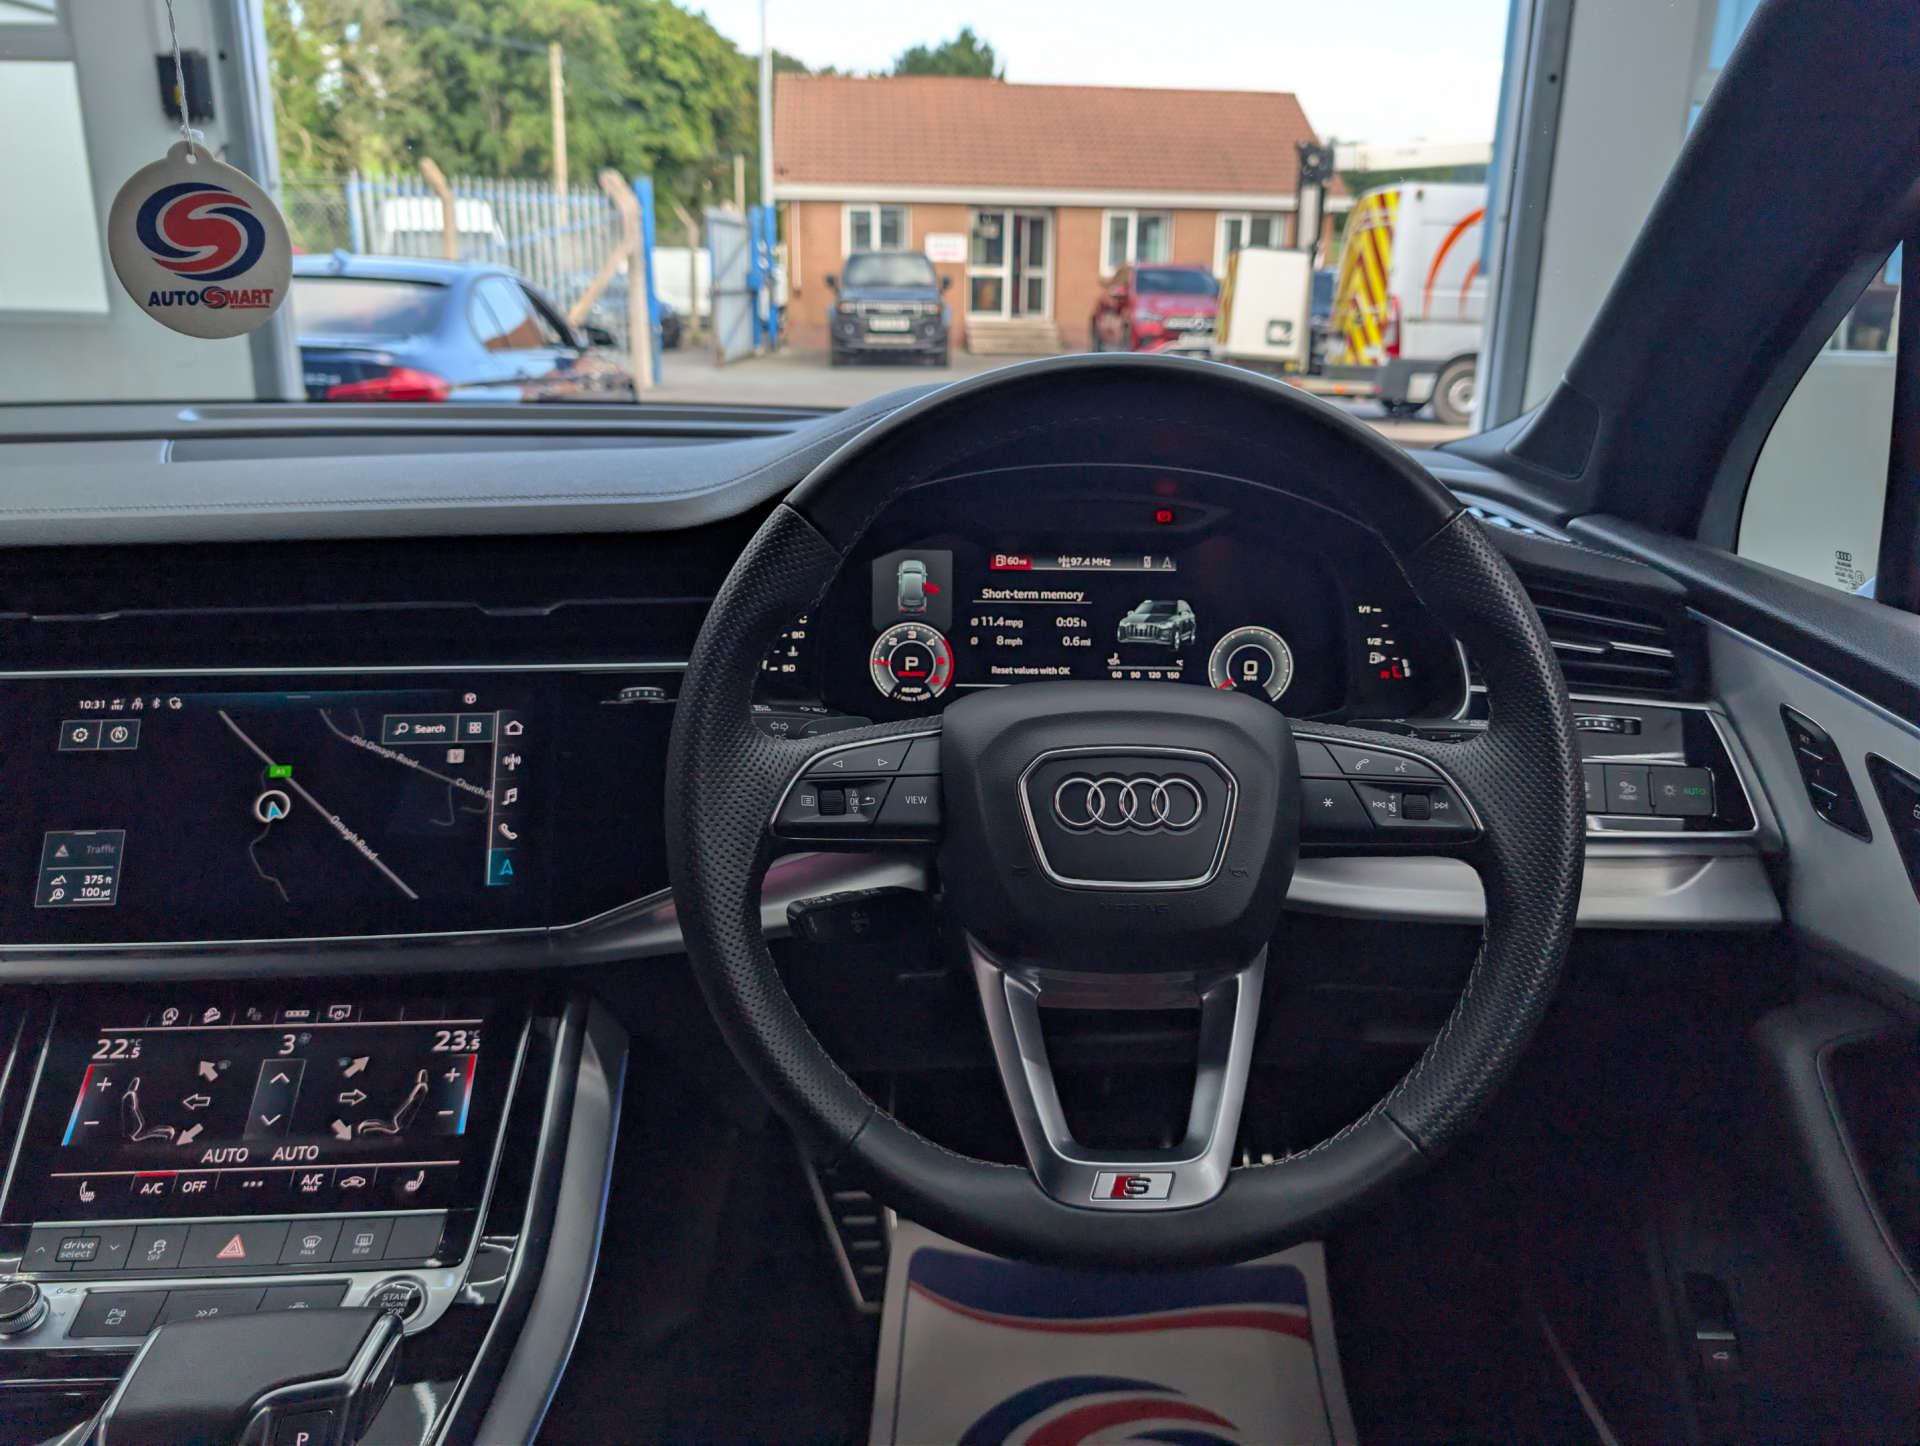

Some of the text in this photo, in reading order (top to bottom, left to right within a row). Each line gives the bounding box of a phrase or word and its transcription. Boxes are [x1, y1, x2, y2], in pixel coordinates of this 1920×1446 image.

[148, 286, 274, 308] AUTOSMART
[1070, 557, 1111, 566] 97.4 MHz
[981, 588, 1084, 602] Short-term memory
[907, 630, 917, 639] 3
[888, 637, 898, 646] 2
[926, 638, 935, 646] 4
[904, 656, 919, 671] P
[1243, 660, 1258, 675] 0
[991, 666, 1070, 675] Reset values with OK
[1111, 671, 1123, 679] 60
[1148, 671, 1161, 679] 120
[79, 700, 106, 710] 10:31
[414, 724, 446, 734] Search
[396, 752, 419, 768] Road
[456, 777, 485, 796] Church
[905, 796, 928, 805] VIEW
[331, 815, 379, 860] Omagh Road
[87, 845, 116, 854] Traffic
[84, 875, 104, 885] 375
[81, 887, 100, 897] 100
[278, 1034, 296, 1055] 3
[200, 1147, 249, 1164] AUTO
[272, 1145, 320, 1161] AUTO
[301, 1173, 324, 1186] A/C
[140, 1182, 164, 1195] A/C
[182, 1181, 208, 1193] OFF
[1123, 1177, 1152, 1195] S
[63, 1240, 96, 1250] drive
[60, 1249, 92, 1259] select
[296, 1432, 309, 1446] P
